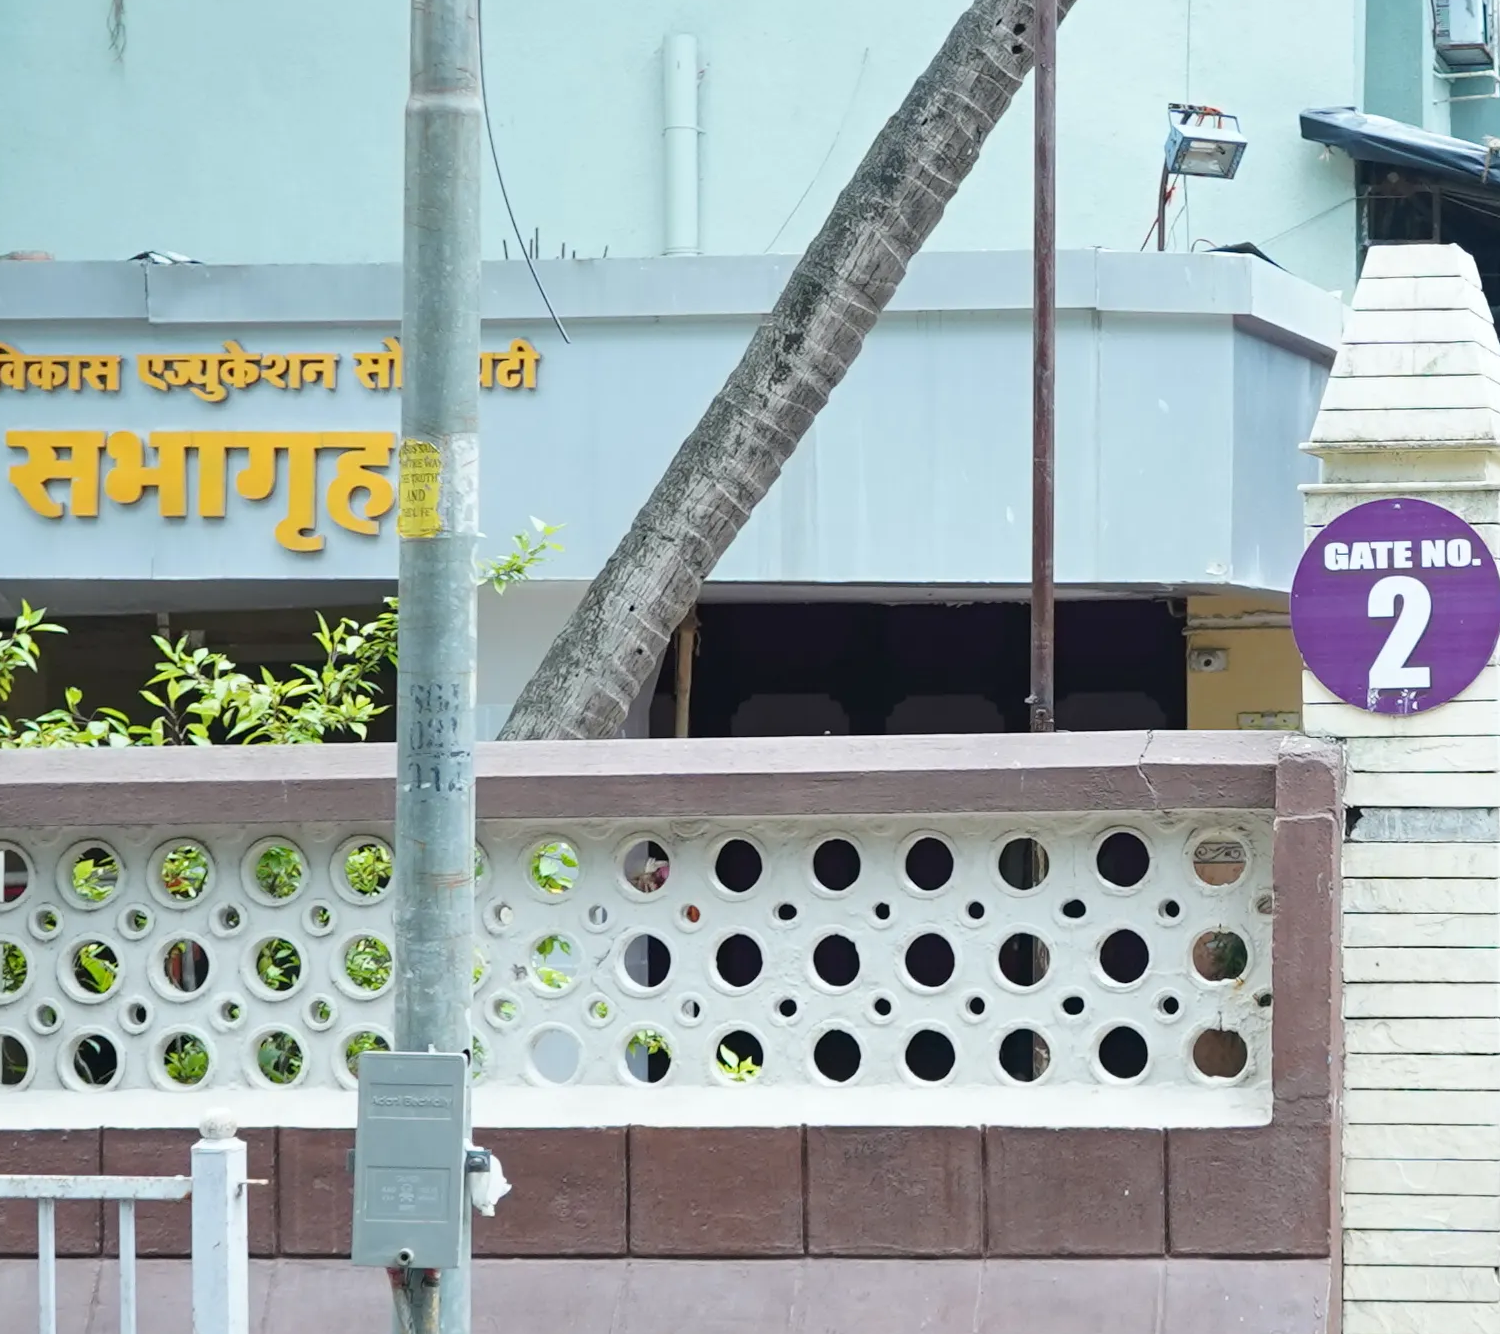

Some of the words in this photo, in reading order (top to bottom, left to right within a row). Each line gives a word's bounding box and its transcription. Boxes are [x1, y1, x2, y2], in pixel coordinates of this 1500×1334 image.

[137, 339, 340, 403] एज्युकेशन
[5, 430, 397, 553] सभागृह
[1324, 540, 1413, 571] GATE
[1421, 538, 1482, 568] NO.
[1367, 575, 1433, 689] 2
